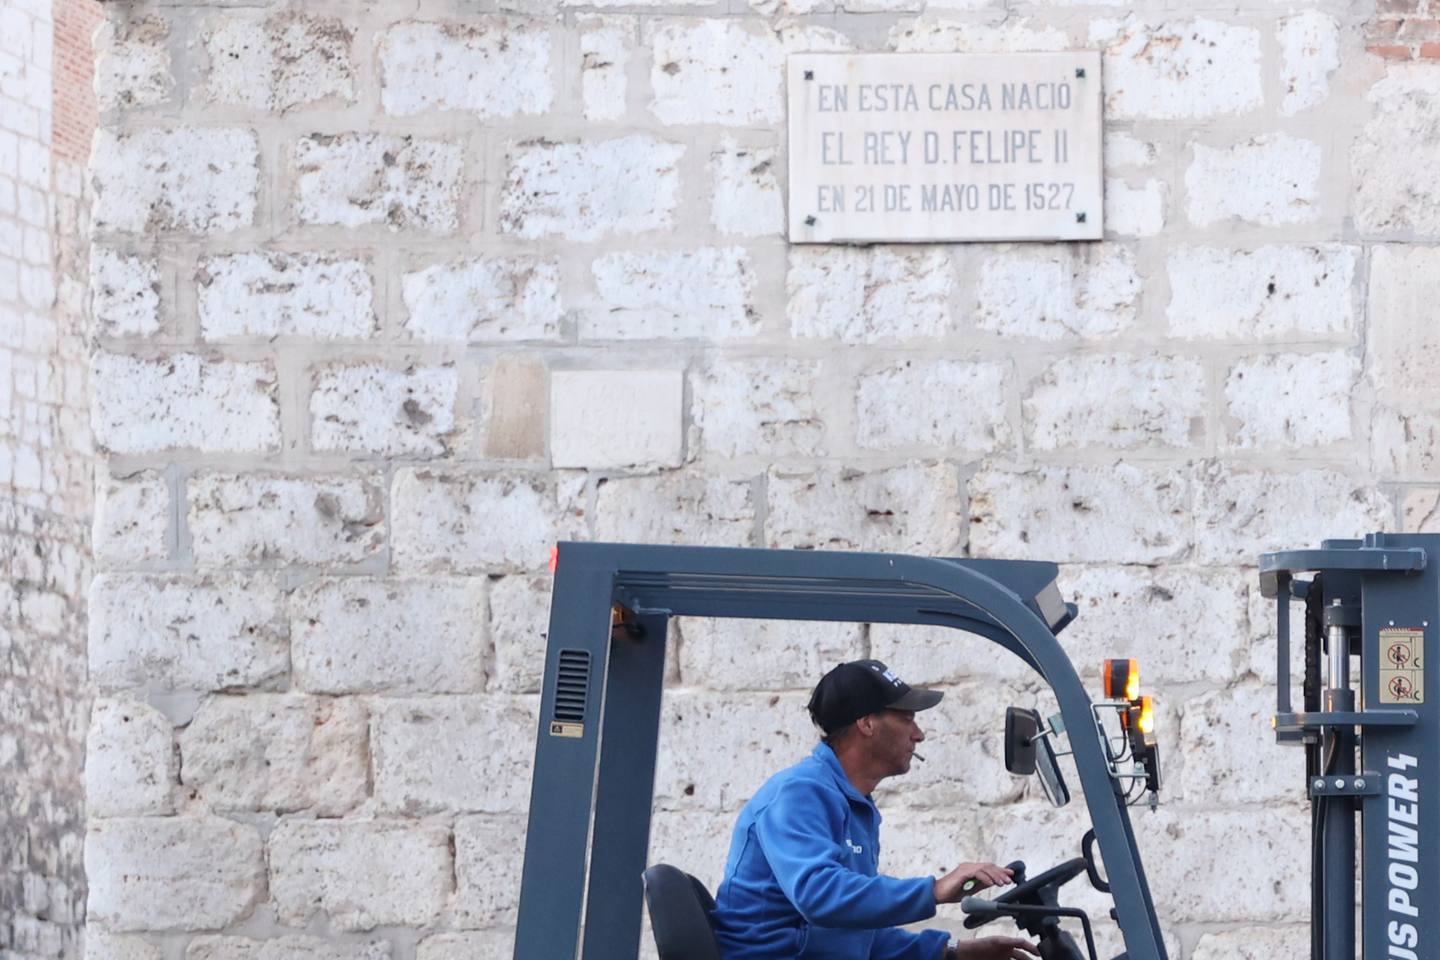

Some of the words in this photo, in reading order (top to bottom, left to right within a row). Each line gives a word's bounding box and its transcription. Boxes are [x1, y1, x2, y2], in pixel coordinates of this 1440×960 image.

[818, 85, 848, 112] EN
[858, 84, 920, 112] ESTA
[928, 83, 992, 112] CASA
[822, 132, 853, 165] EL
[864, 131, 912, 165] REY
[1054, 129, 1068, 163] II
[818, 185, 845, 212] EN
[855, 185, 875, 212] 21
[884, 185, 912, 212] DE
[921, 184, 979, 212] MAYO
[989, 183, 1016, 211] DE
[1025, 183, 1075, 211] 1527
[1388, 773, 1419, 917] POWER
